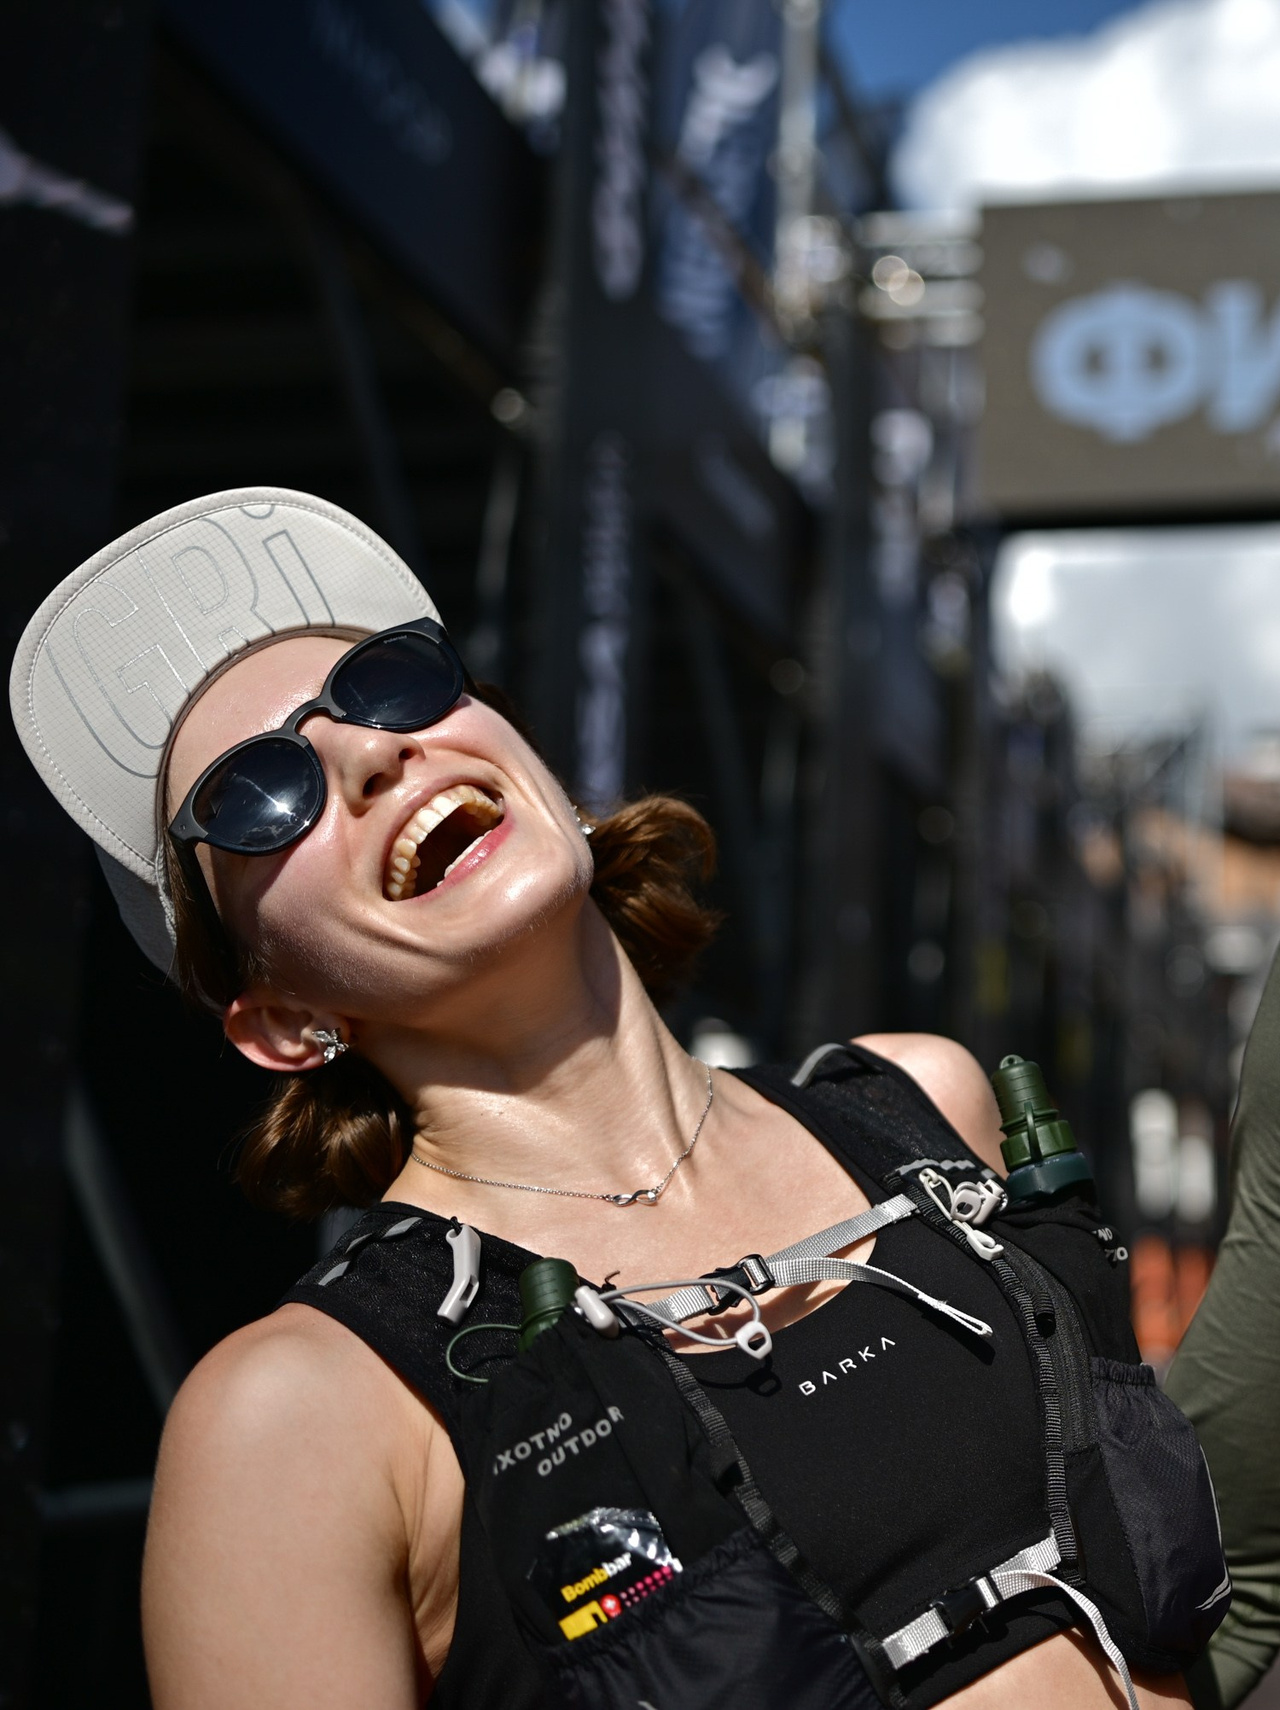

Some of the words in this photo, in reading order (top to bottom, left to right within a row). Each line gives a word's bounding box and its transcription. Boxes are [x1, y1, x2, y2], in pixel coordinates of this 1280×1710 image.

[799, 1336, 896, 1396] BARKA
[493, 1412, 573, 1476] XOTNO
[560, 1552, 632, 1603] Bombbar
